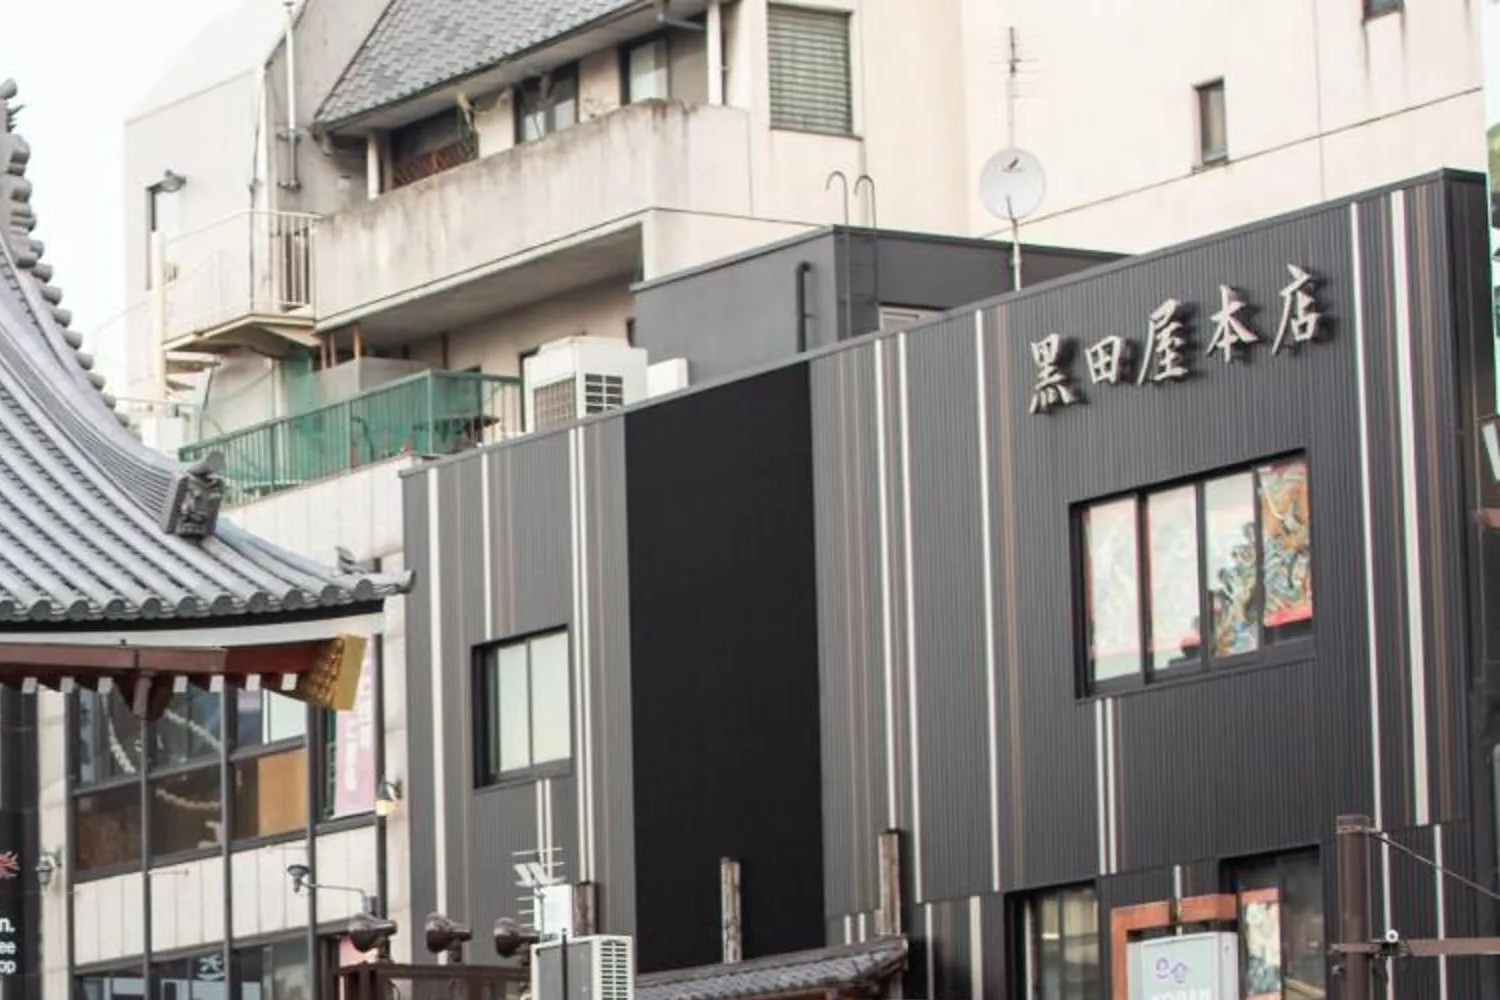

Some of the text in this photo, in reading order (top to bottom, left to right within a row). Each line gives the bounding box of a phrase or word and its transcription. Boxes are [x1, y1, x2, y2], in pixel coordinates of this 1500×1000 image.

[1029, 263, 1322, 415] 黒田屋本店
